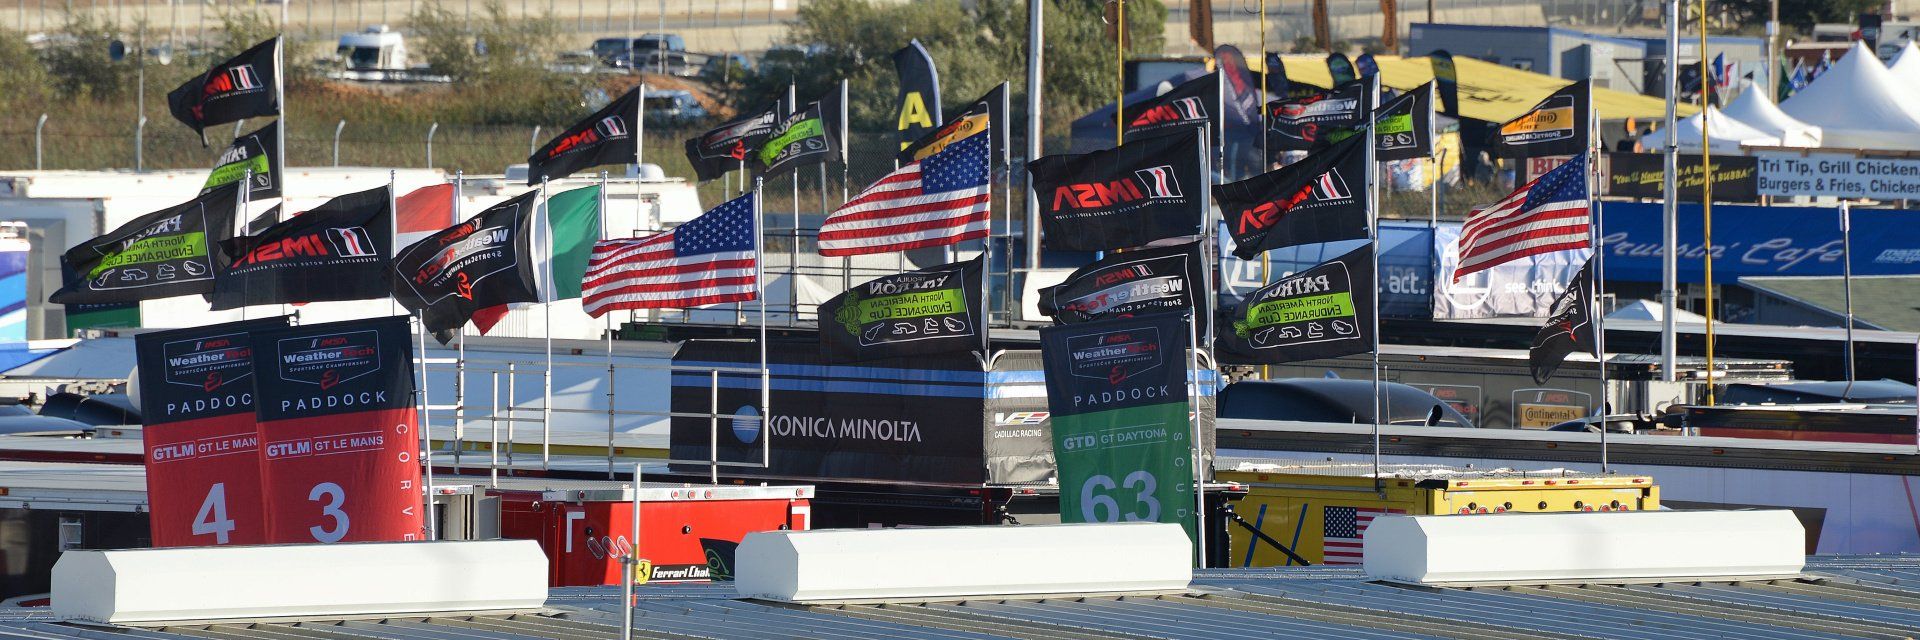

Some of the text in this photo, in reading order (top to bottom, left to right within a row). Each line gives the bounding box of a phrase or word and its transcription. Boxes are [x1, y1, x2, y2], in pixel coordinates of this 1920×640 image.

[1760, 160, 1780, 173] Tri
[1785, 160, 1814, 177] Tip,
[1819, 161, 1851, 174] Grill
[1759, 176, 1811, 194] Burgers
[1815, 178, 1825, 191] &
[1829, 178, 1866, 195] Fries,
[284, 346, 375, 365] WeatherTech
[1073, 342, 1158, 361] WeatherTech
[175, 366, 208, 376] SPORTSCAR
[290, 360, 370, 373] SPORTSCAR CHAMPIONSHIP
[167, 393, 252, 415] PADDOC
[282, 391, 386, 412] PADDOCK
[1074, 385, 1169, 407] PADDOCK
[1525, 408, 1572, 421] Continental
[769, 415, 922, 442] KONICA MINOLTA
[994, 429, 1043, 439] CADILLAC RACING
[1063, 428, 1168, 450] GTD GT DAYTONA
[153, 437, 258, 461] GTLM GT LE MAN
[267, 435, 385, 458] GTLM GT LE MANS
[1081, 470, 1162, 525] 63
[192, 482, 236, 545] 4
[309, 482, 350, 544] 3
[651, 566, 688, 579] Ferrari
